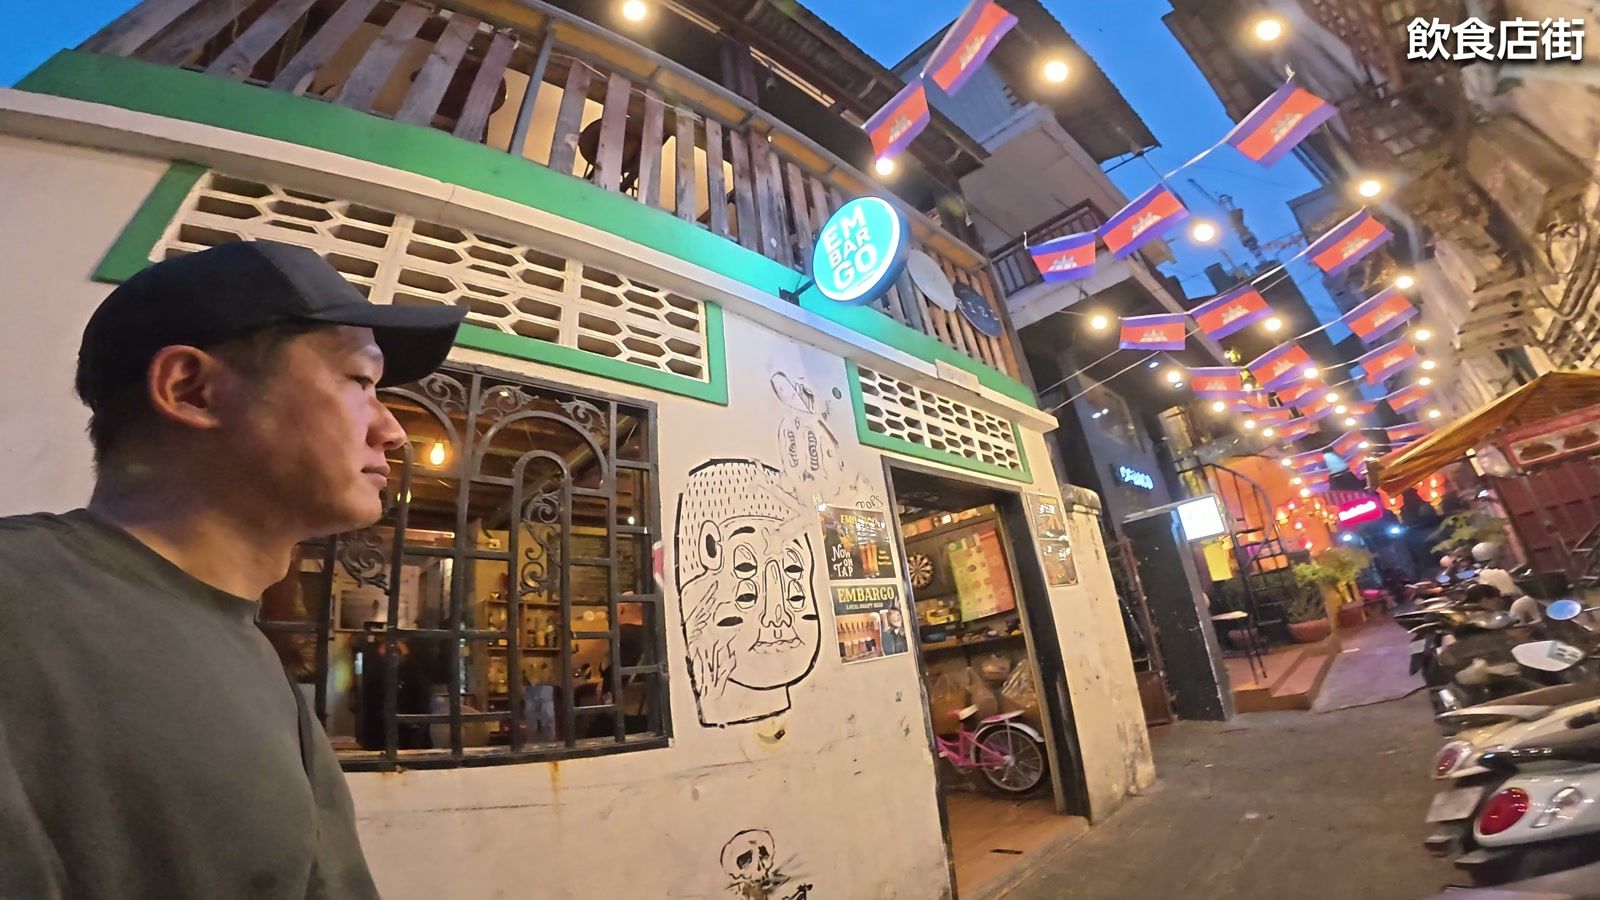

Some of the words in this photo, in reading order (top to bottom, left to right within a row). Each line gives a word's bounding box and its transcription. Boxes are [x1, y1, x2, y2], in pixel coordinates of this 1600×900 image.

[822, 205, 867, 251] EM
[828, 227, 872, 269] BAR
[833, 242, 878, 290] GO
[833, 561, 854, 578] TAP
[836, 586, 895, 603] EMBARGO
